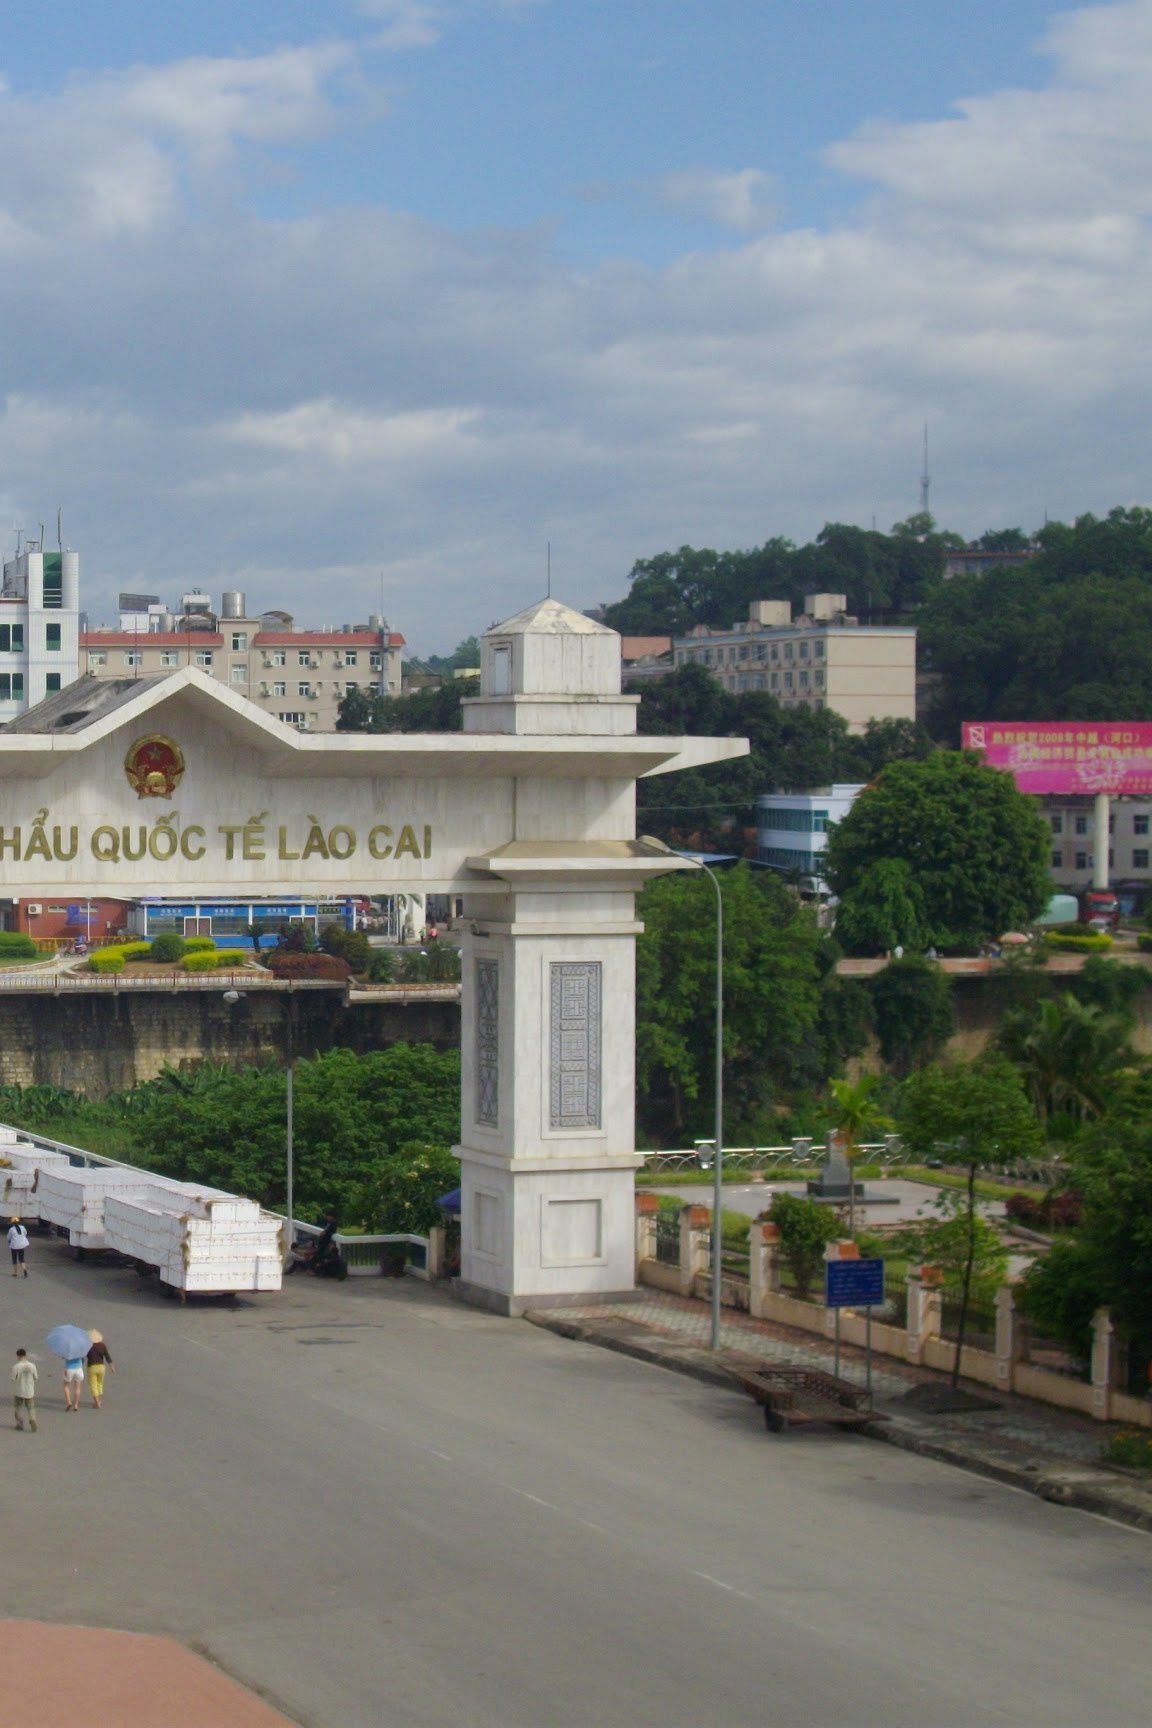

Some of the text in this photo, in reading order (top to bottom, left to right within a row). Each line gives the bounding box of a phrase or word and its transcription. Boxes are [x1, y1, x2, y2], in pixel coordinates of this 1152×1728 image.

[91, 810, 206, 863] QUỐC
[218, 811, 269, 861] TẾ
[279, 814, 356, 861] LÀO
[368, 824, 432, 861] CAI
